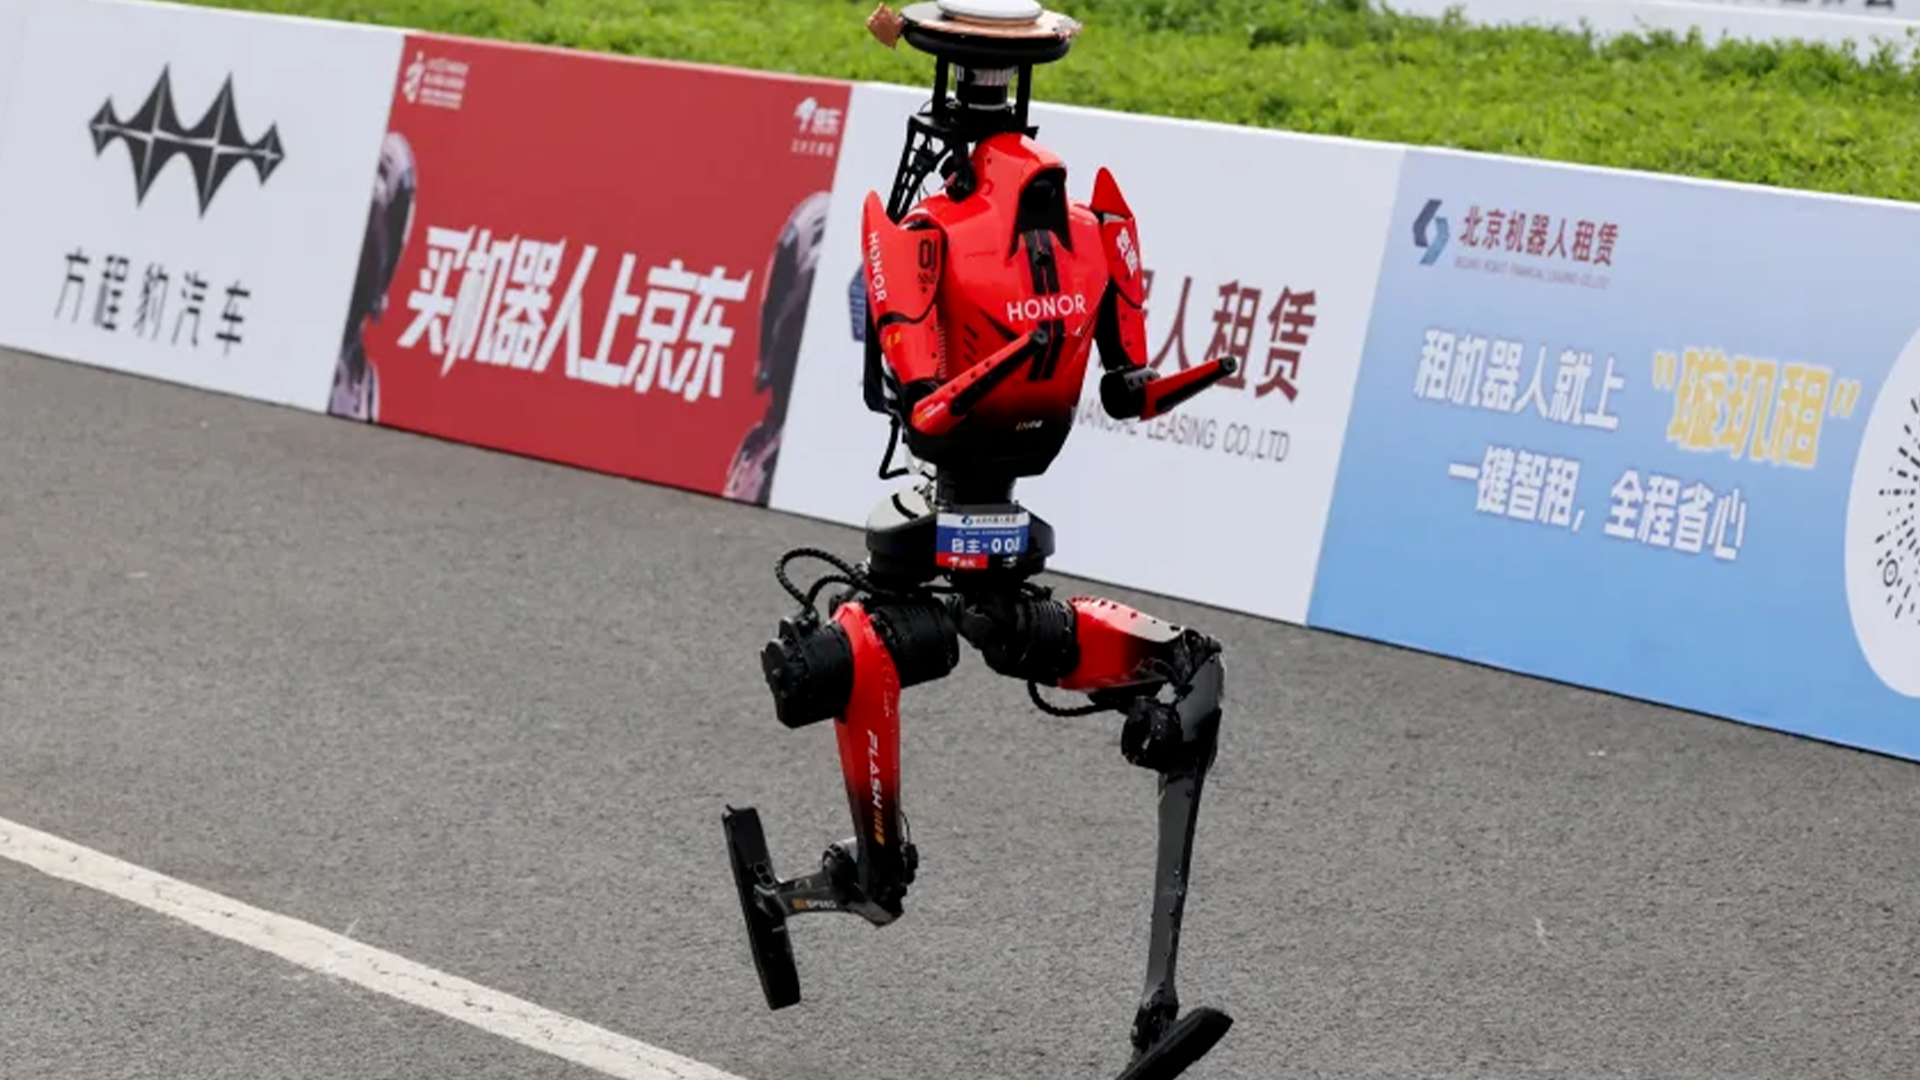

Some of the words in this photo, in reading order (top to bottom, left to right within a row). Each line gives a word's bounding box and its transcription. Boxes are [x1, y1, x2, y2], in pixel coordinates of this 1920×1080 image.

[868, 231, 888, 303] HONOR
[1459, 205, 1619, 267] 北京机器人租赁
[54, 247, 251, 357] 方程豹汽车
[397, 224, 753, 402] 买机器人上京东
[1006, 294, 1087, 322] HONOR
[1142, 269, 1317, 403] 人租赁
[1412, 328, 1626, 432] 租机器人就上
[866, 729, 883, 810] FLASH
